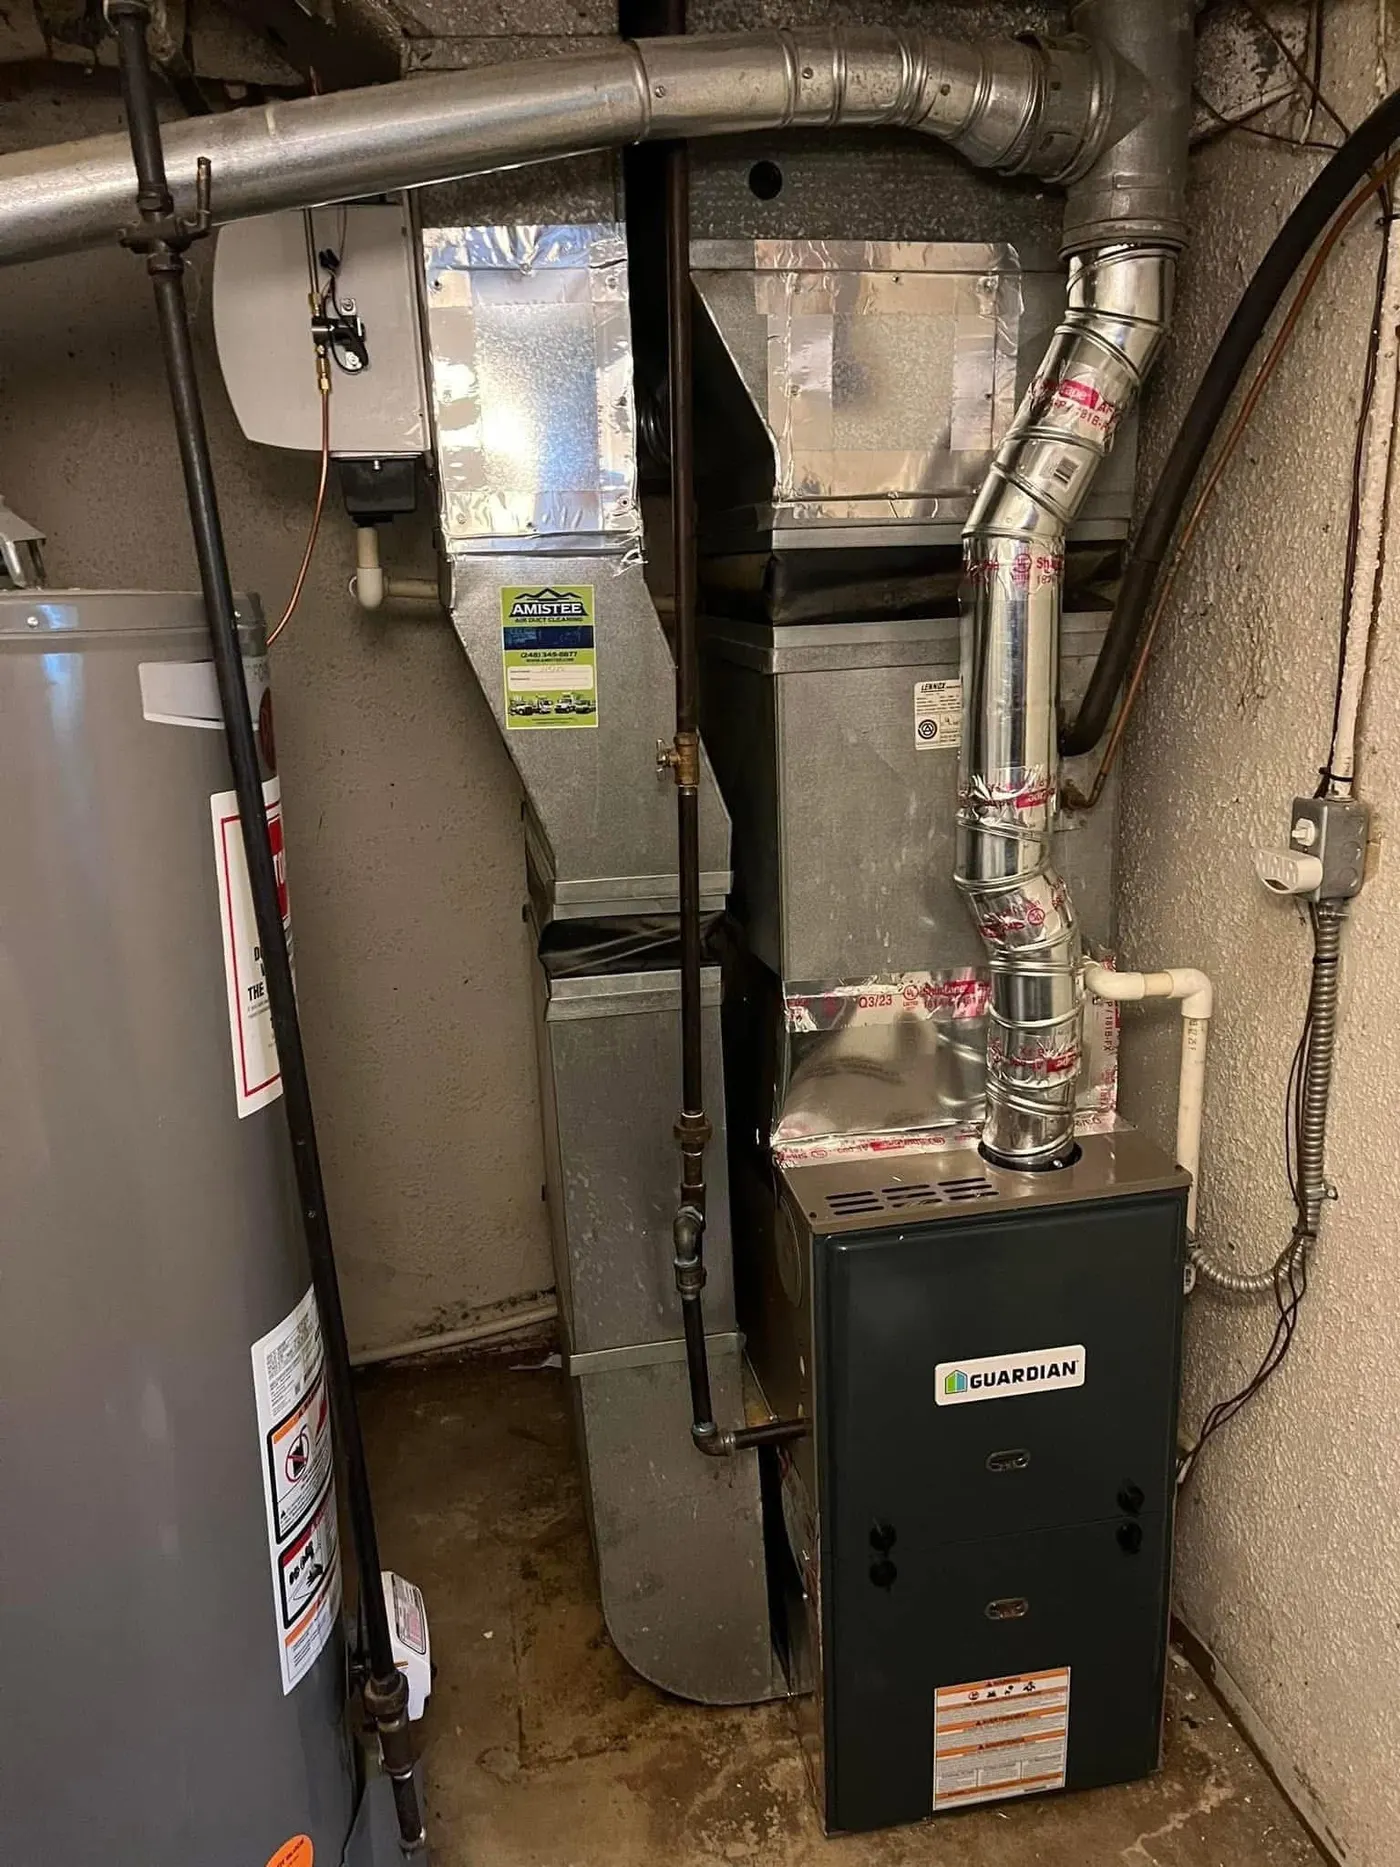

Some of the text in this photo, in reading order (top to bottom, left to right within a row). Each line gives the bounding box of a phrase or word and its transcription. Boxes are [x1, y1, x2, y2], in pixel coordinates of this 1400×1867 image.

[512, 603, 582, 615] AMISTEE
[247, 982, 265, 1001] THE
[858, 995, 893, 1008] Q3/23
[969, 1360, 1076, 1390] GUARDIAN
